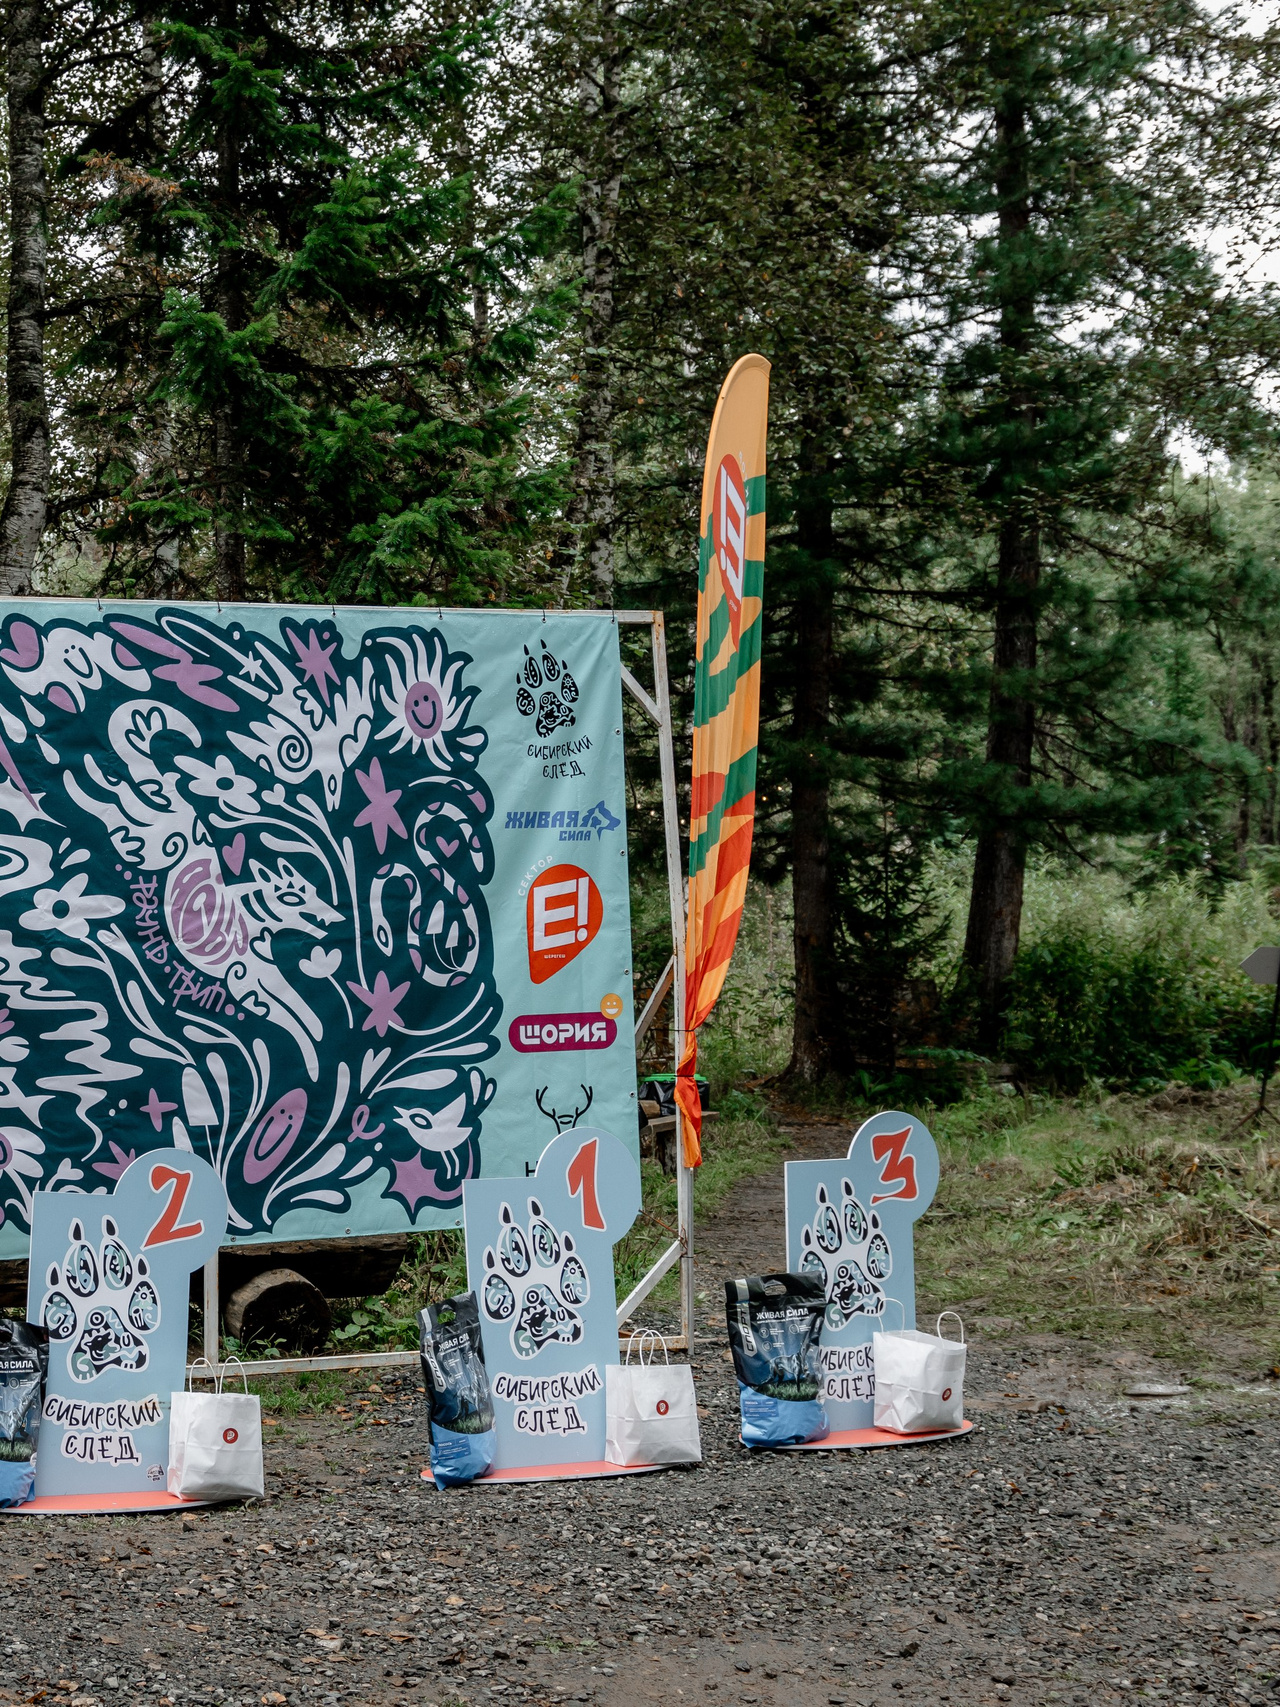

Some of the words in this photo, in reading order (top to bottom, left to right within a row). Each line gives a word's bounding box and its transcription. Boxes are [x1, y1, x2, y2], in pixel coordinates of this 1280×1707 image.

[527, 734, 593, 760] СИБИРСКИЙ
[505, 810, 580, 829] ЖИВАЯ
[558, 830, 591, 841] СИЛА
[517, 855, 553, 896] СЕКТОР
[519, 1021, 607, 1045] ШОРИЯ
[871, 1125, 919, 1204] 3
[567, 1137, 606, 1231] 1
[142, 1164, 204, 1250] 2
[740, 1308, 754, 1352] СПОРТ
[756, 1310, 785, 1320] ЖИВАЯ
[786, 1308, 809, 1317] СИЛА
[10, 1360, 34, 1369] СИЛА
[495, 1368, 602, 1402] СИБИРСКИЙ
[44, 1397, 161, 1429] СИБИРСКИЙ
